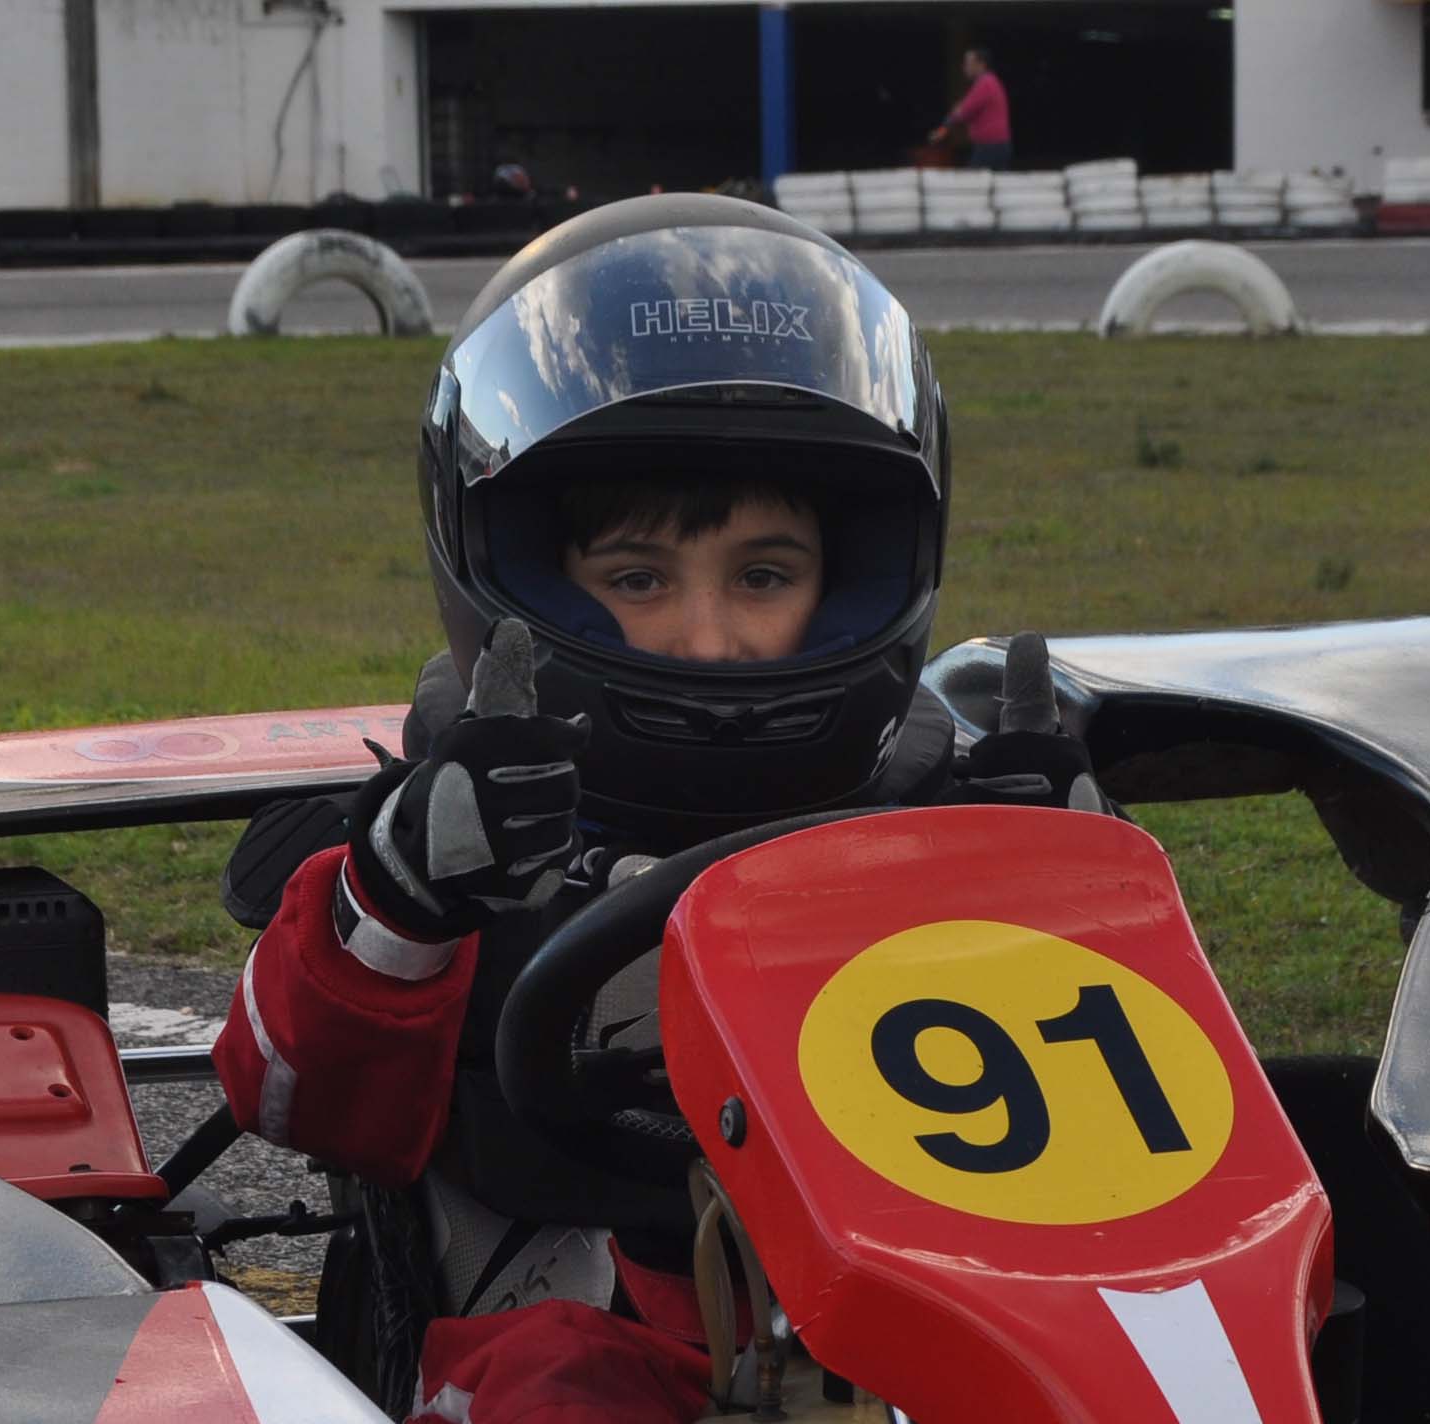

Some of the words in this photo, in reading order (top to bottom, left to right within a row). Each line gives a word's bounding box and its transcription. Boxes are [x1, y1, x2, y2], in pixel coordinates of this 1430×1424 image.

[630, 298, 815, 342] HELIX
[670, 333, 784, 345] HELMETS
[871, 984, 1193, 1174] 91
